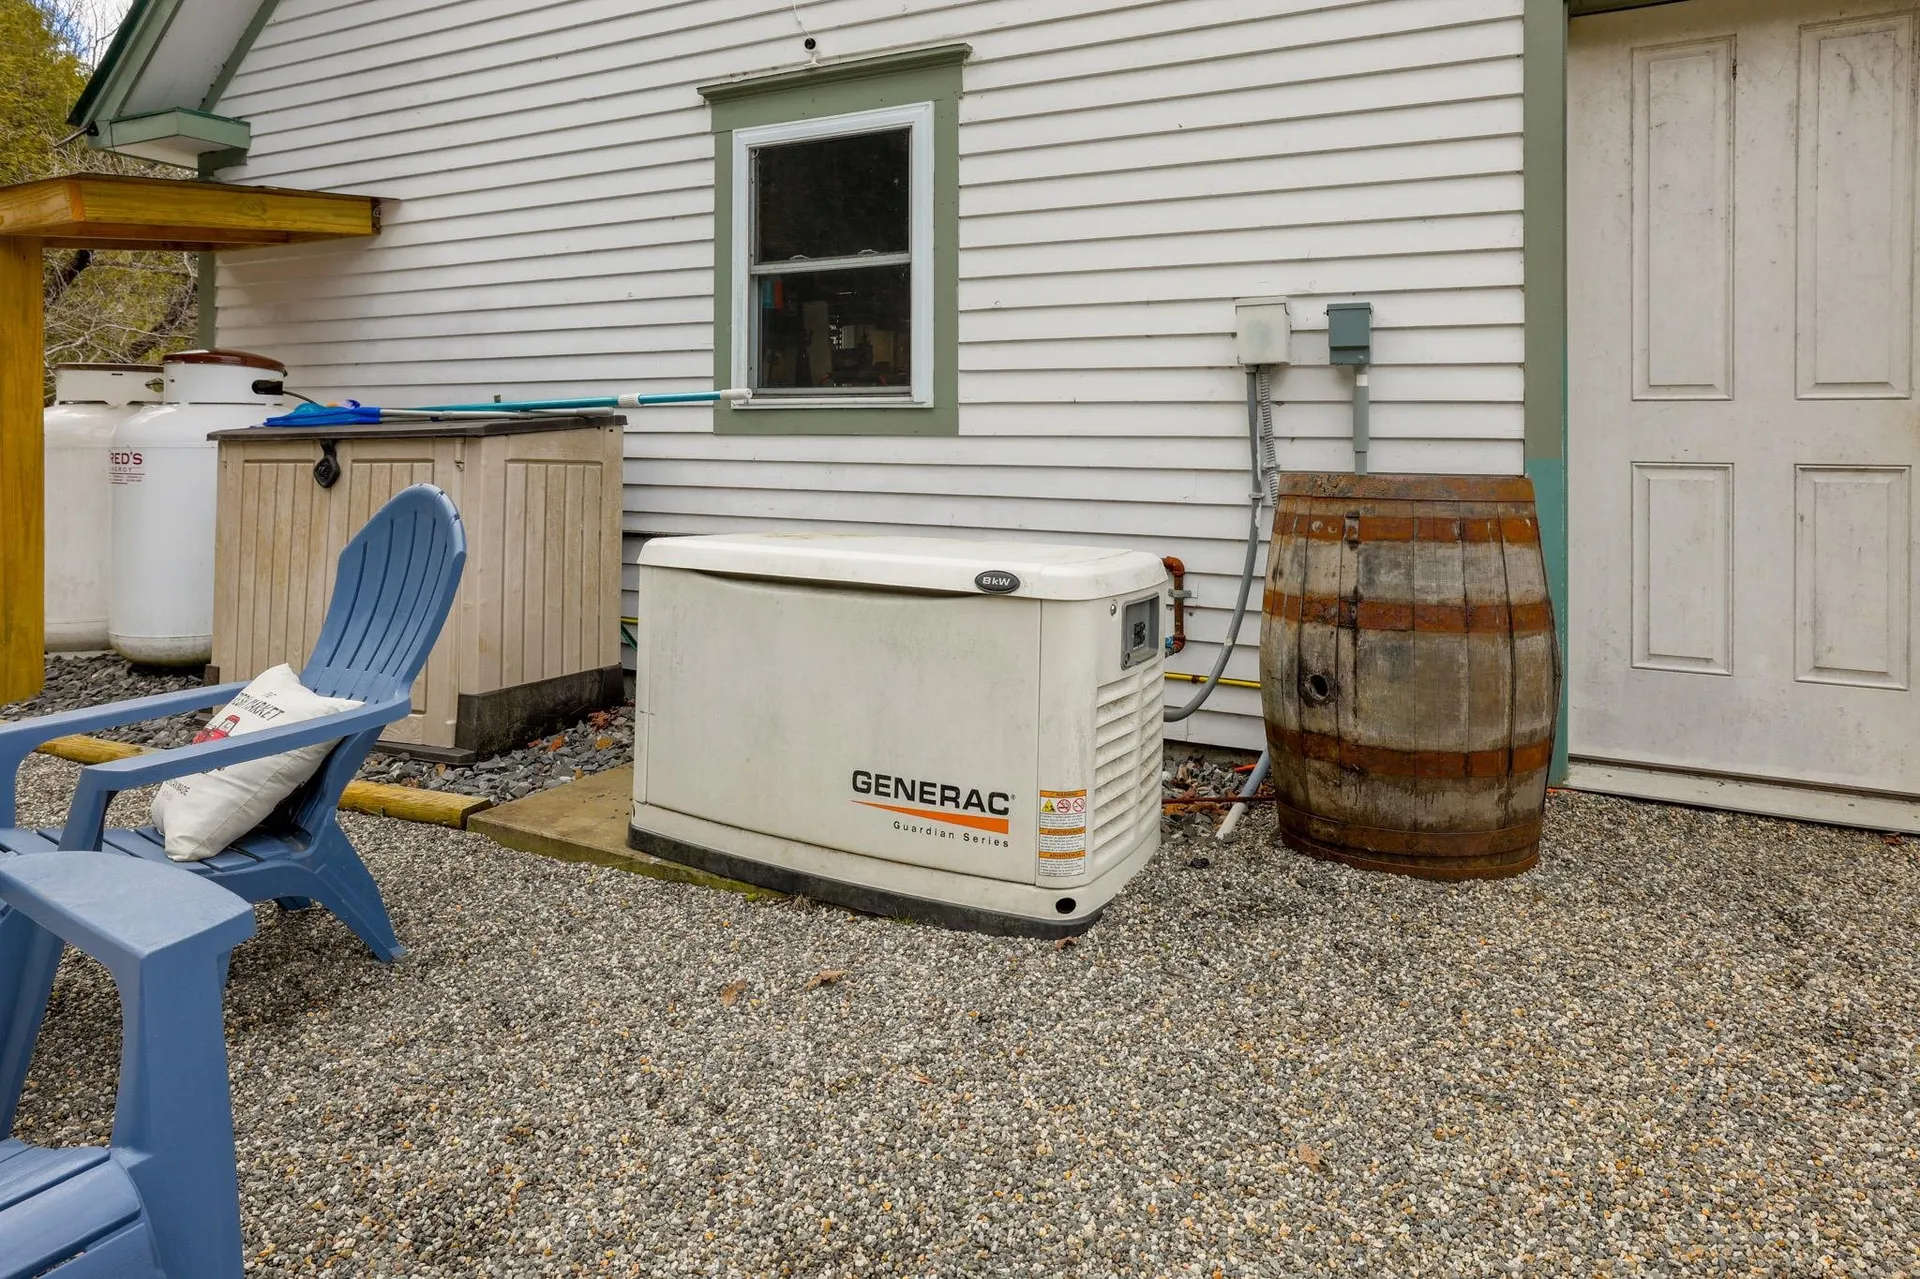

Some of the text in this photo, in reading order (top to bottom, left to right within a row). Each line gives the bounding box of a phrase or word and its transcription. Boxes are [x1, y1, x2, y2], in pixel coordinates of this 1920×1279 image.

[982, 576, 1011, 586] 8kW
[852, 769, 1010, 816] GENERAC
[893, 820, 1010, 848] Guardian Series
